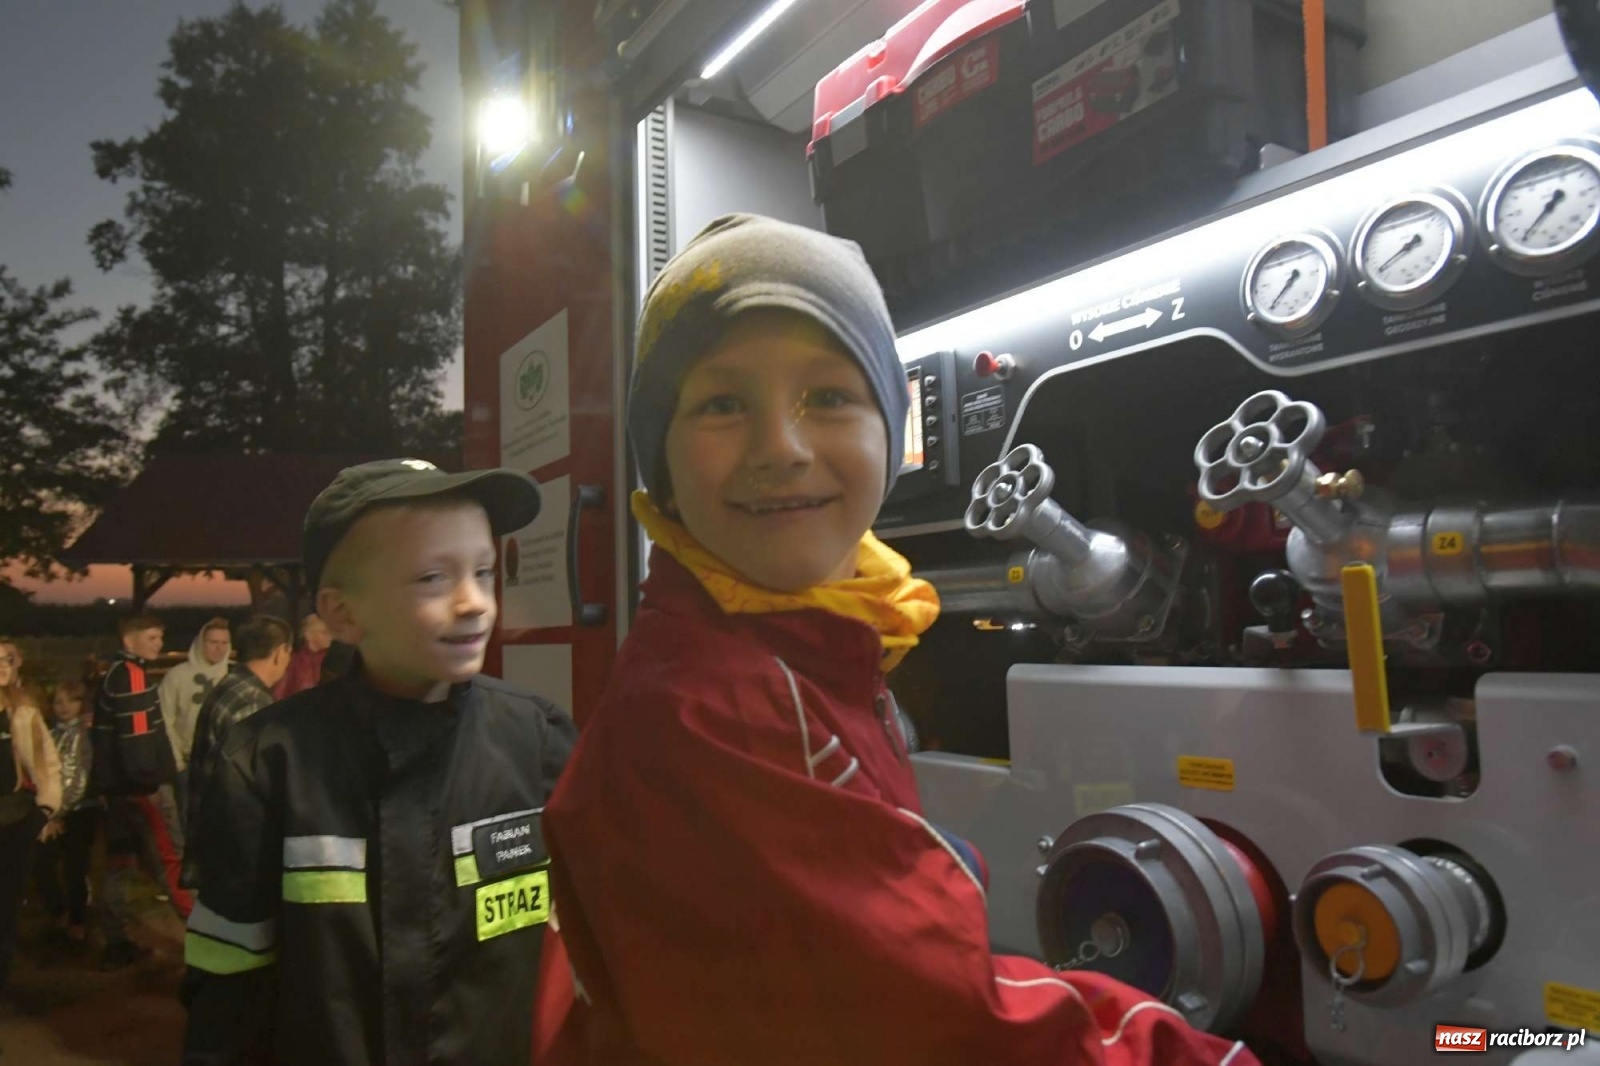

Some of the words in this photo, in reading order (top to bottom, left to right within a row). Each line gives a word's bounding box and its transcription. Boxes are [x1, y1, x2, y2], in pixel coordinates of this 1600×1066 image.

[1171, 296, 1186, 321] Z
[1439, 536, 1456, 550] Z4
[490, 824, 531, 845] FABIAN
